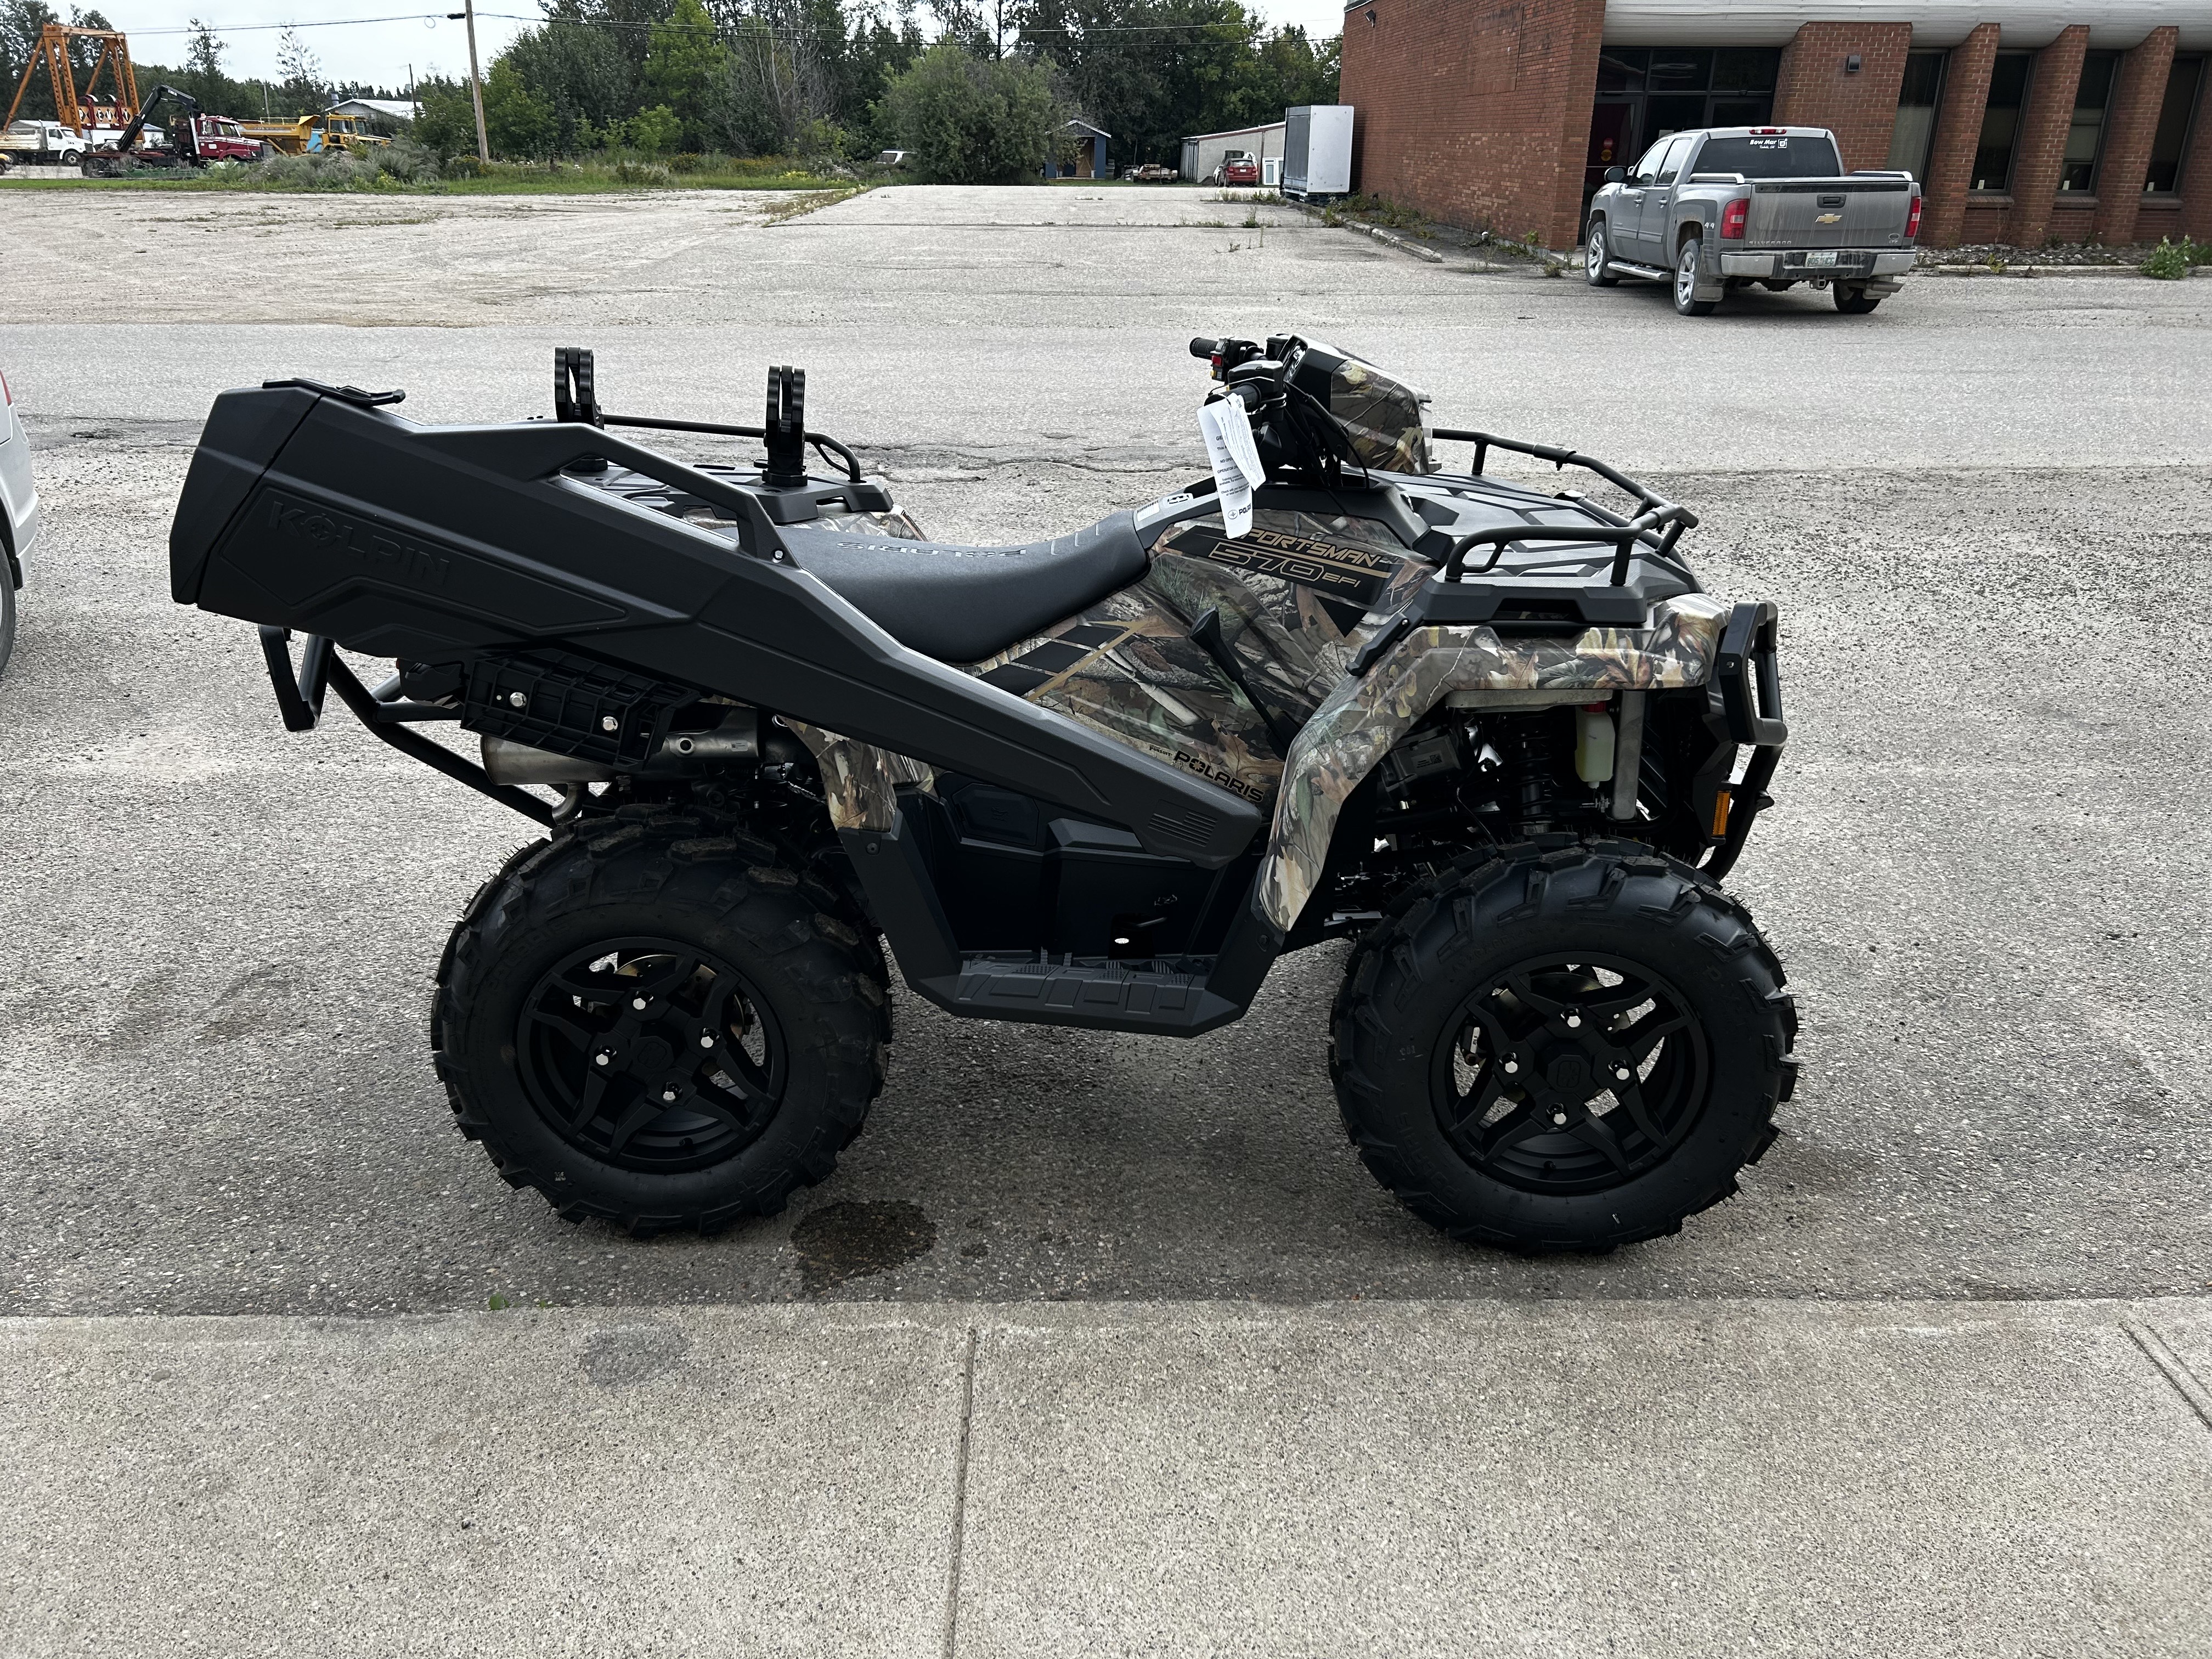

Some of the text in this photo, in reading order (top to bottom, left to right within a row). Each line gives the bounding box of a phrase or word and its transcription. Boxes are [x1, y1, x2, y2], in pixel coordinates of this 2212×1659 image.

[268, 500, 450, 588] KOLPIN
[836, 541, 1027, 558] POLARIS
[1208, 541, 1362, 588] 570 EFI
[1224, 528, 1380, 567] PORTSMAN
[1173, 750, 1264, 802] POLARIS
[1395, 1111, 1463, 1201] POLARIS
